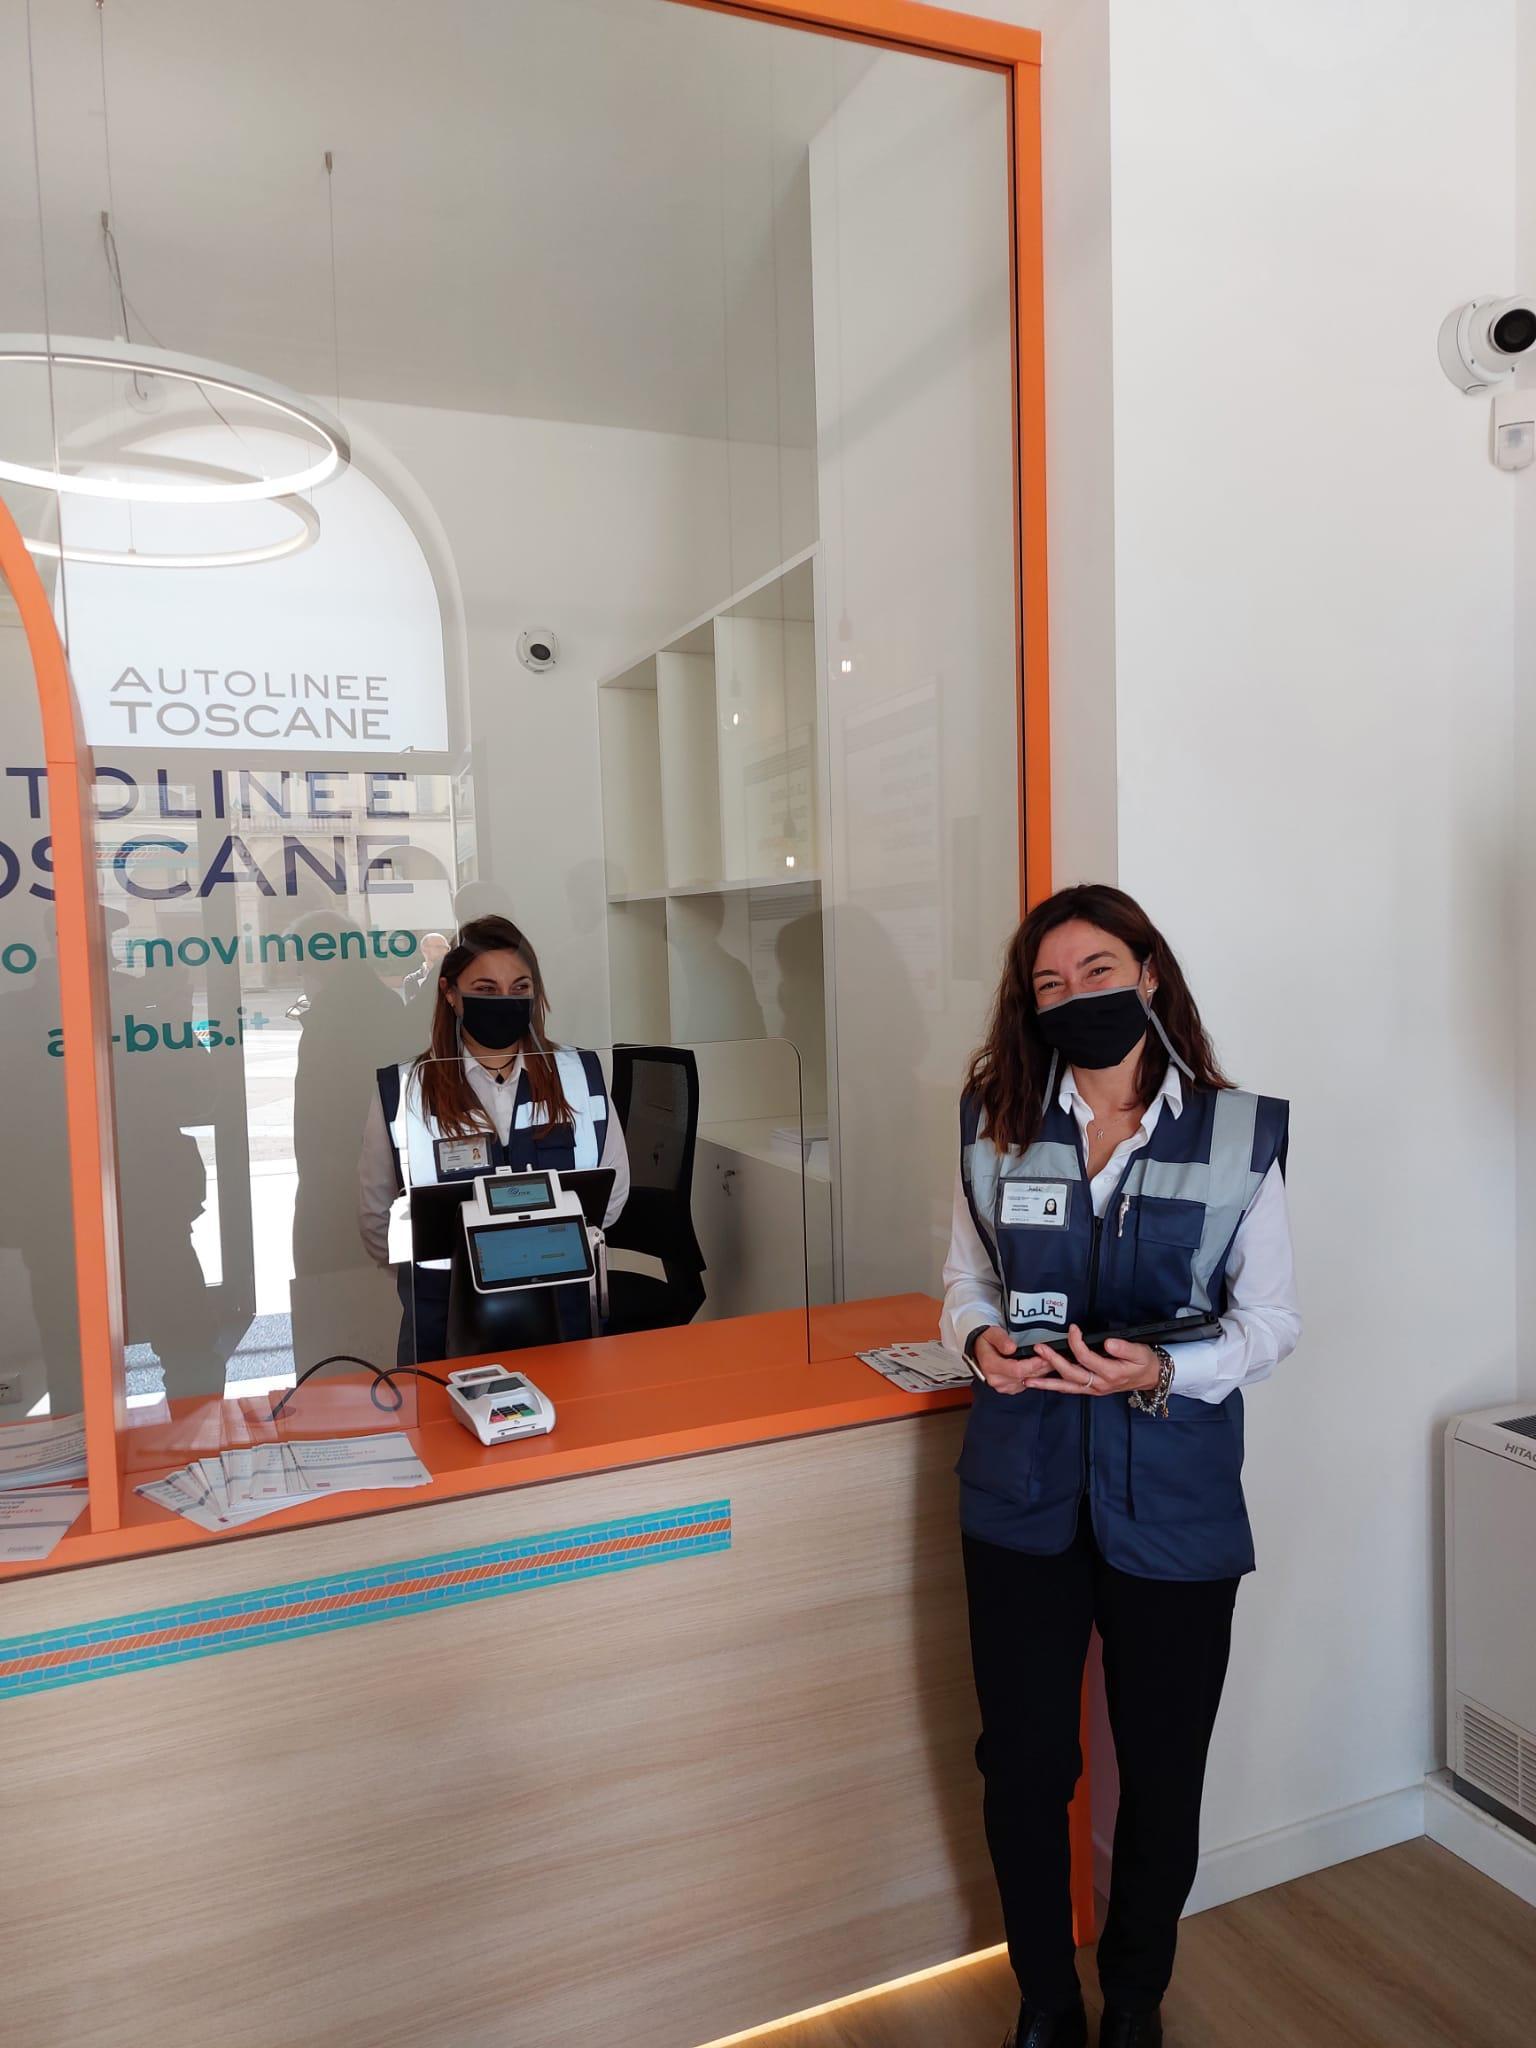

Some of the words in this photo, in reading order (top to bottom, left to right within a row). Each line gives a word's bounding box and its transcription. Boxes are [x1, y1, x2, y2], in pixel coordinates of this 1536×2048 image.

[110, 667, 389, 702] AUTOLINEE
[109, 701, 391, 740] TOSCANE
[126, 923, 417, 969] movimento
[47, 1006, 270, 1058] a-bus.it
[1010, 1297, 1063, 1319] hola
